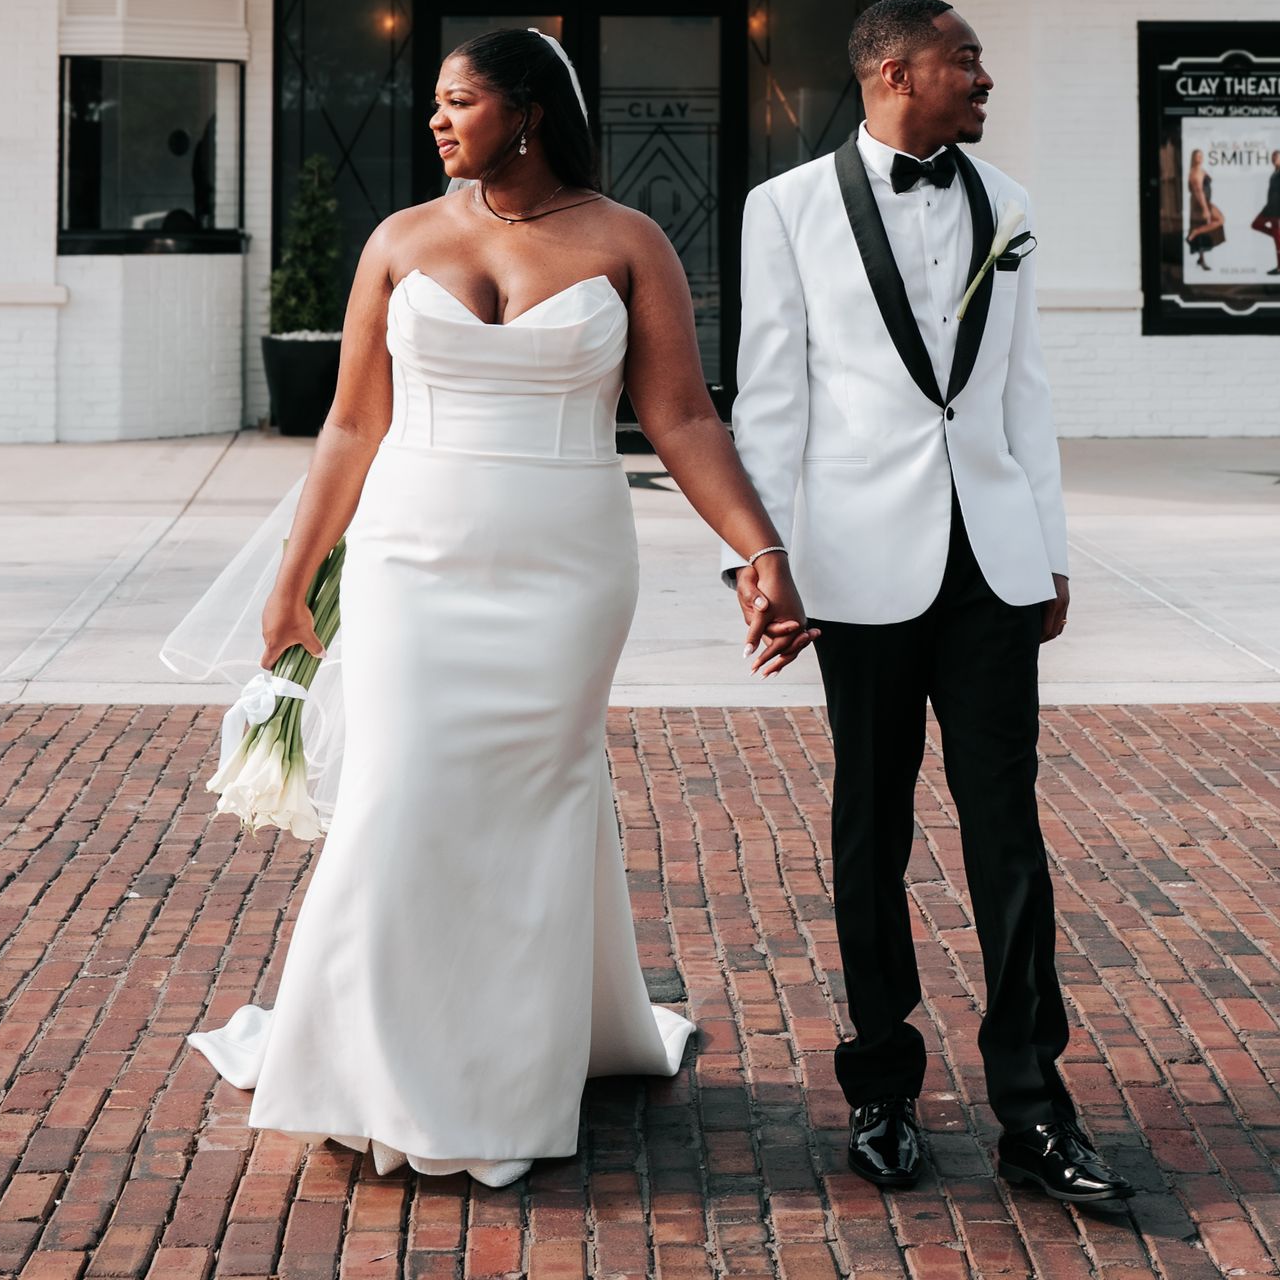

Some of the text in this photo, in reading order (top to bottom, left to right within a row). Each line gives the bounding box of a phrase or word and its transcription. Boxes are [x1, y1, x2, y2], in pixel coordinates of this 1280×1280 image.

[1175, 77, 1220, 96] CLAY
[627, 102, 690, 118] CLAY
[1197, 105, 1279, 117] NOW SHOWING
[1207, 150, 1270, 167] SMITH
